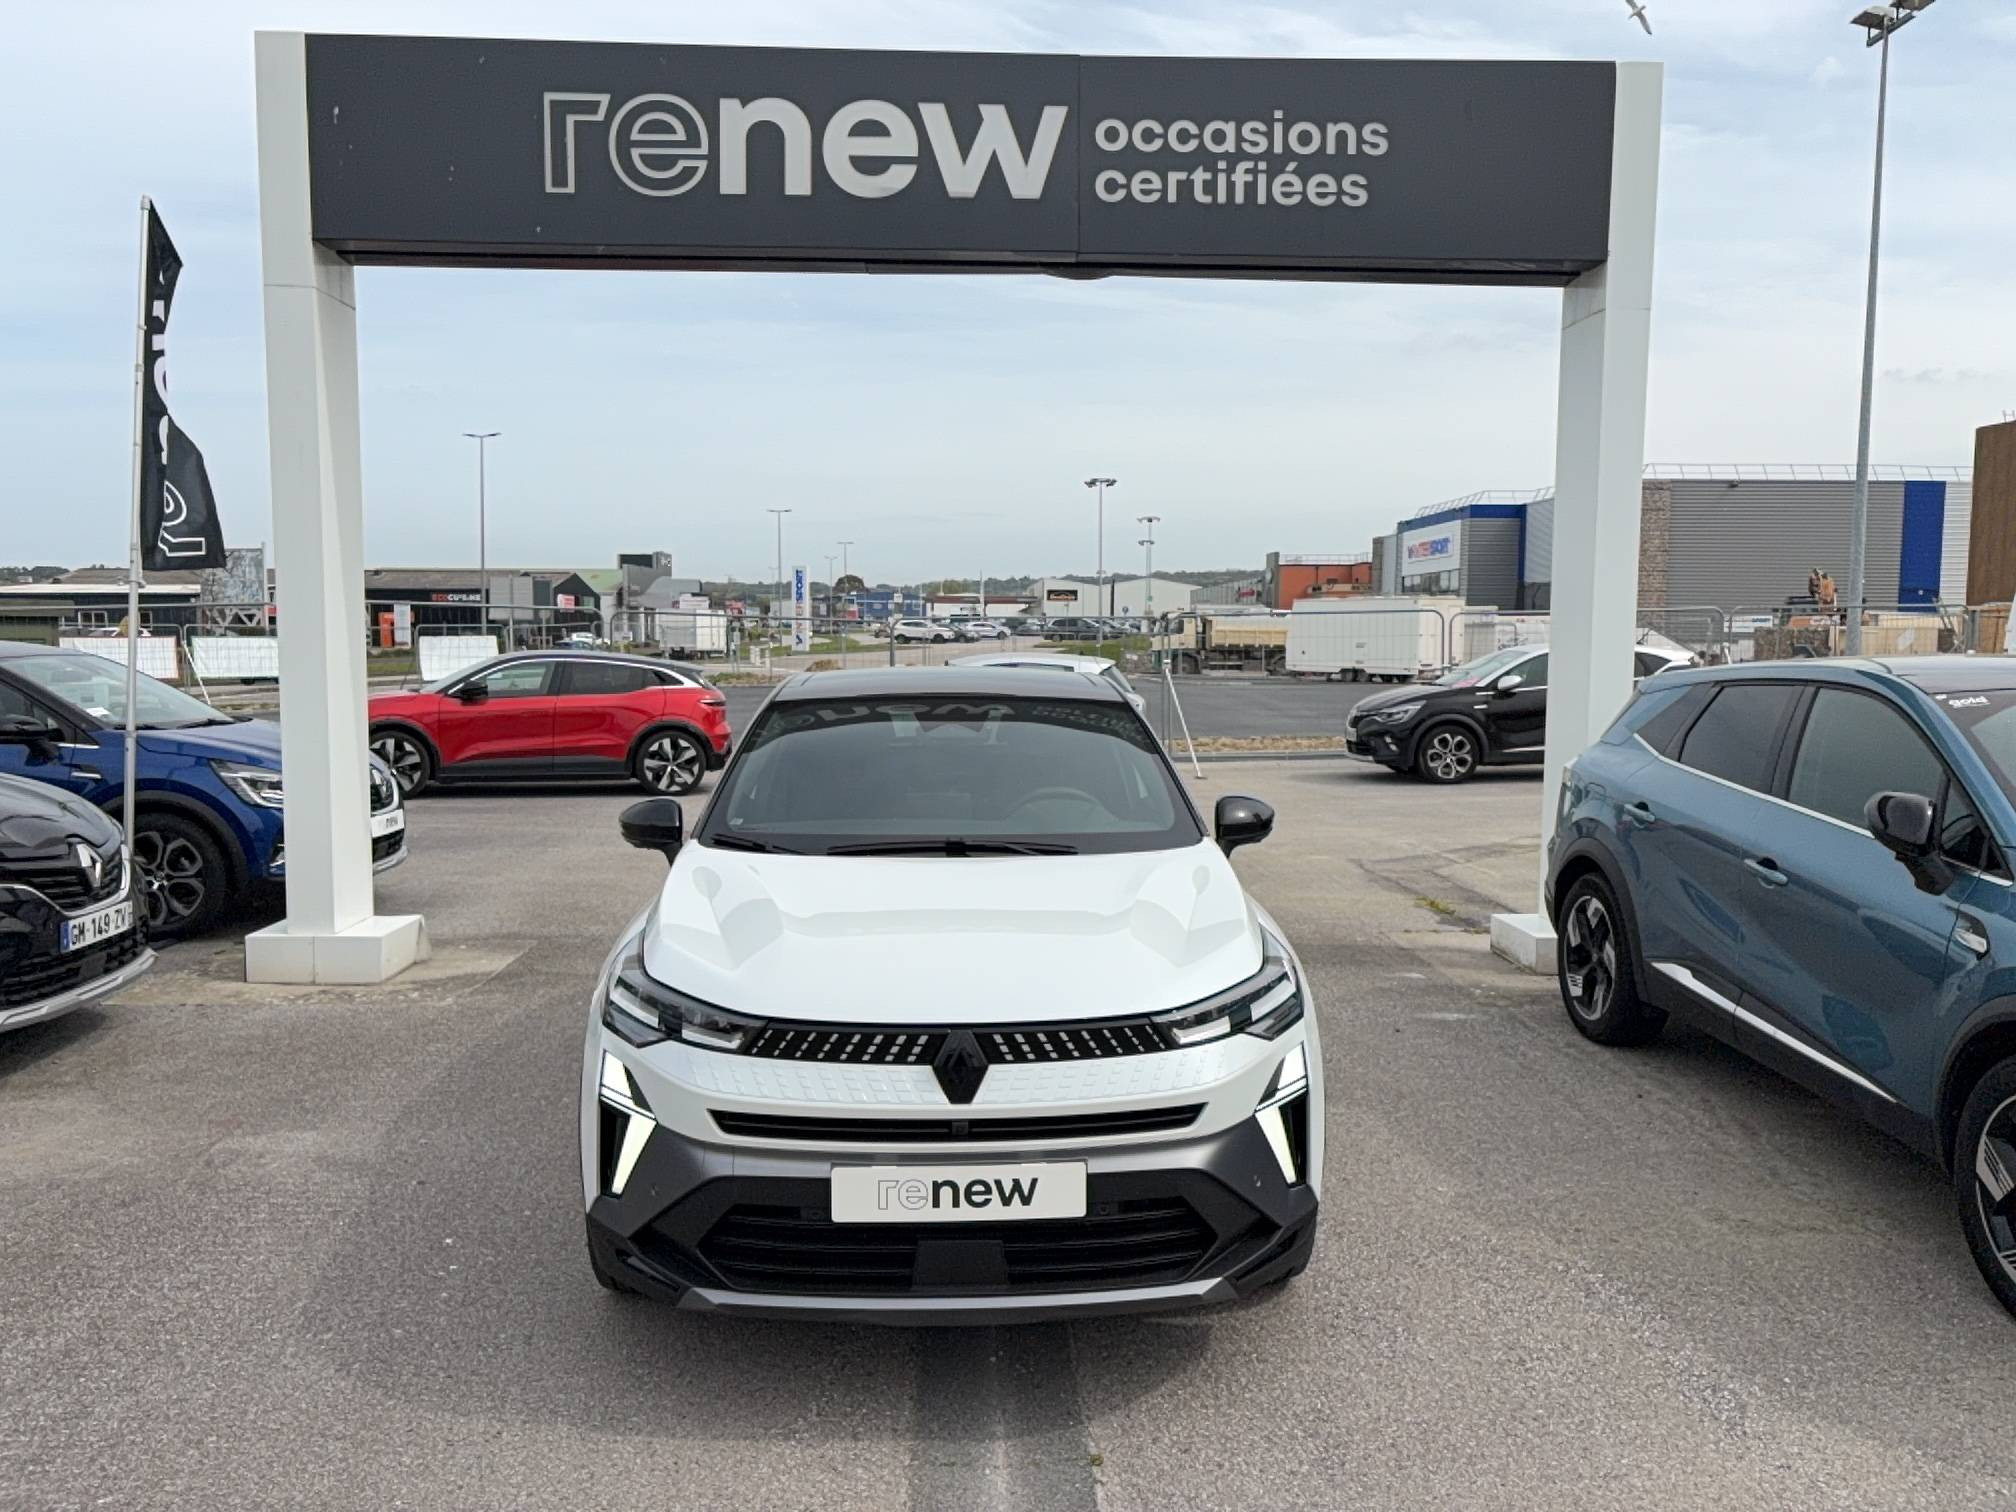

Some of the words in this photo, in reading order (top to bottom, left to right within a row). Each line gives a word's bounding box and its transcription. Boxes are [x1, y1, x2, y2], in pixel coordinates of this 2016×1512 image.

[543, 91, 1069, 200] renew
[1095, 109, 1389, 155] occasions
[1095, 160, 1369, 207] certifiées
[877, 1177, 1039, 1210] renew
